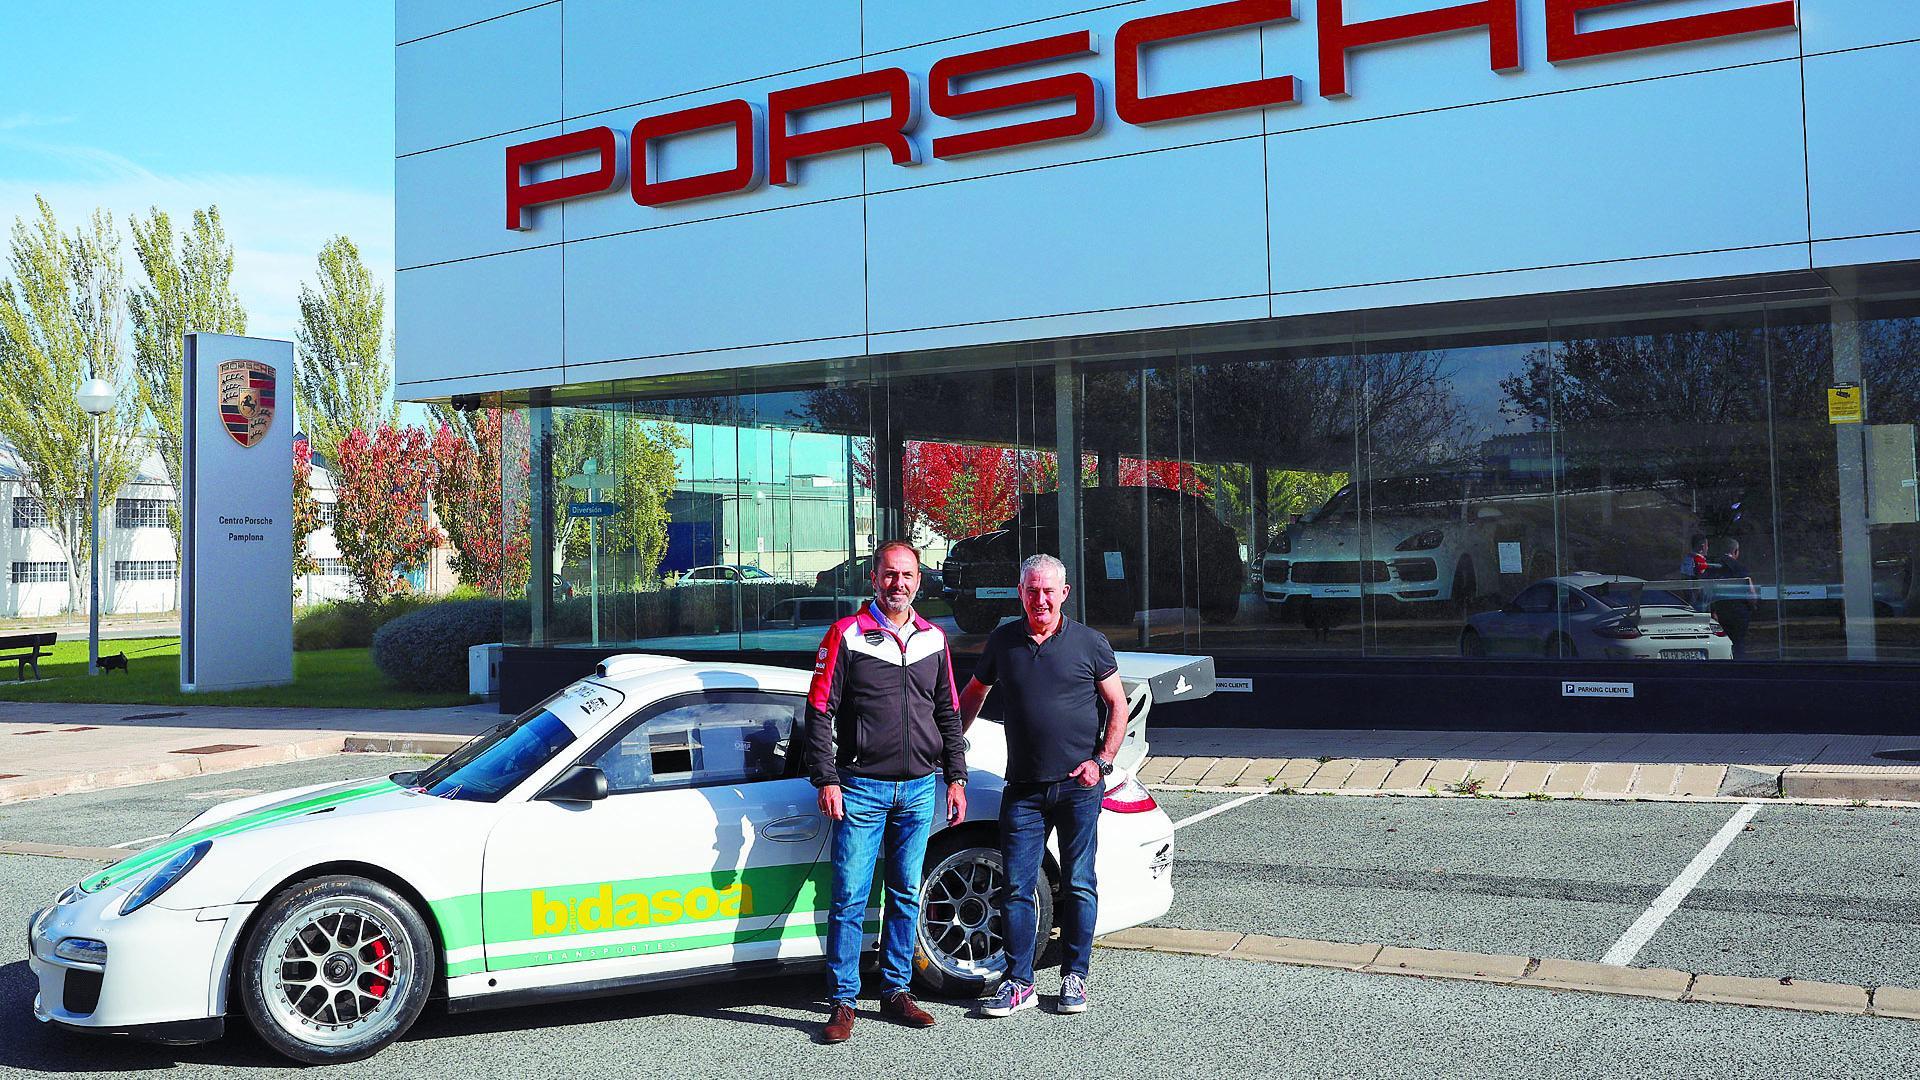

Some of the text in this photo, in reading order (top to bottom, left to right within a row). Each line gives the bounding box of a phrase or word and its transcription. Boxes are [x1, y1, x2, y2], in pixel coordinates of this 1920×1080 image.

[506, 0, 1797, 231] PORSCHE
[572, 504, 602, 514] Diversión
[219, 515, 273, 525] Centro Porsche
[228, 532, 264, 543] Pamplona
[534, 941, 678, 962] TRANSPORTES
